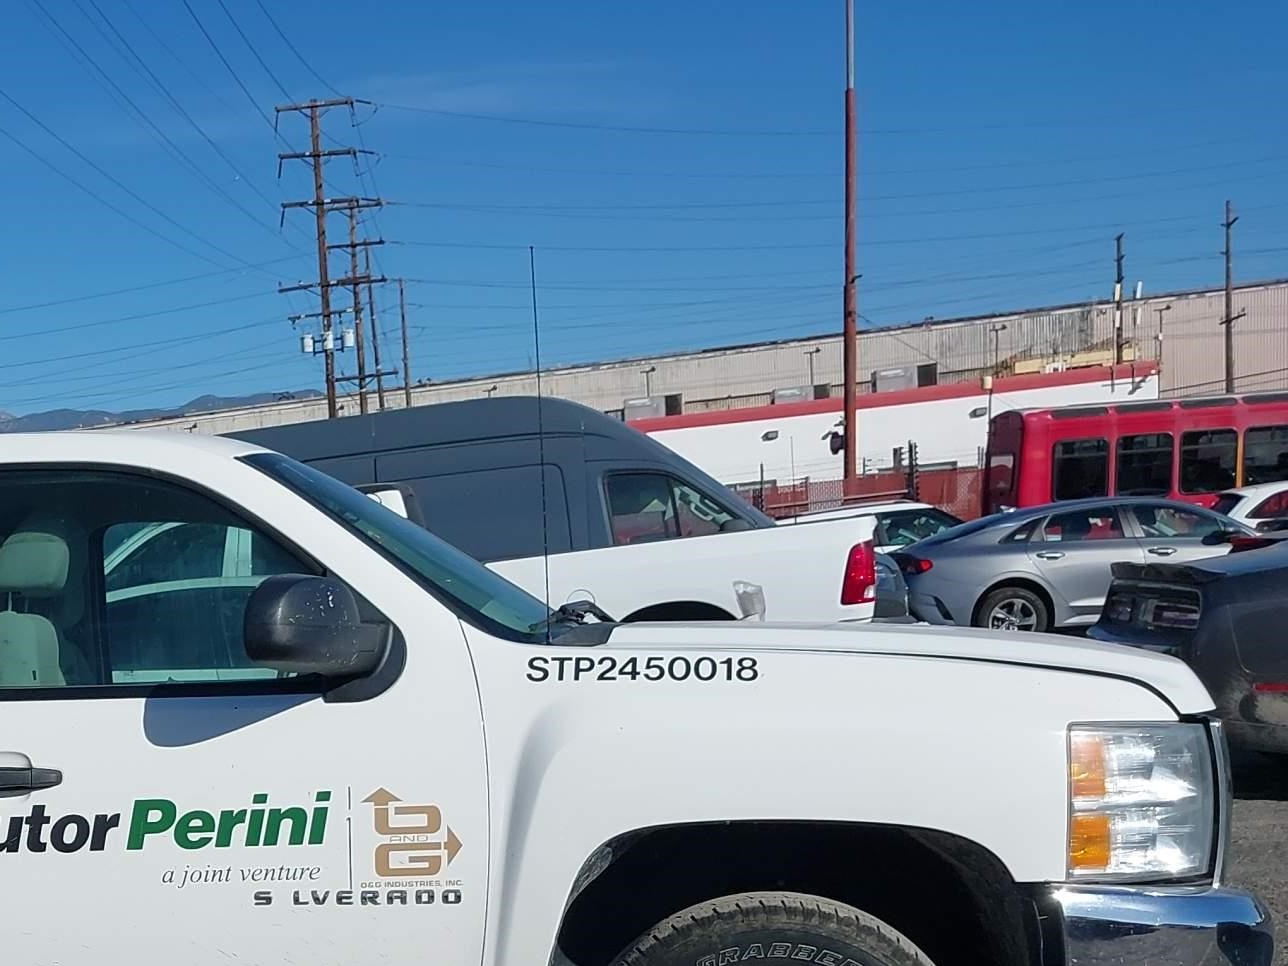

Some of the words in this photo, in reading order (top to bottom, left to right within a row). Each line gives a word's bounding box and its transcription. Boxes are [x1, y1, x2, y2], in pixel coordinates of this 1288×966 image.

[526, 656, 759, 682] STP2450018
[126, 791, 332, 850] Perini
[389, 834, 429, 843] AND
[161, 868, 175, 884] a
[177, 864, 232, 889] joint
[239, 864, 321, 882] venture
